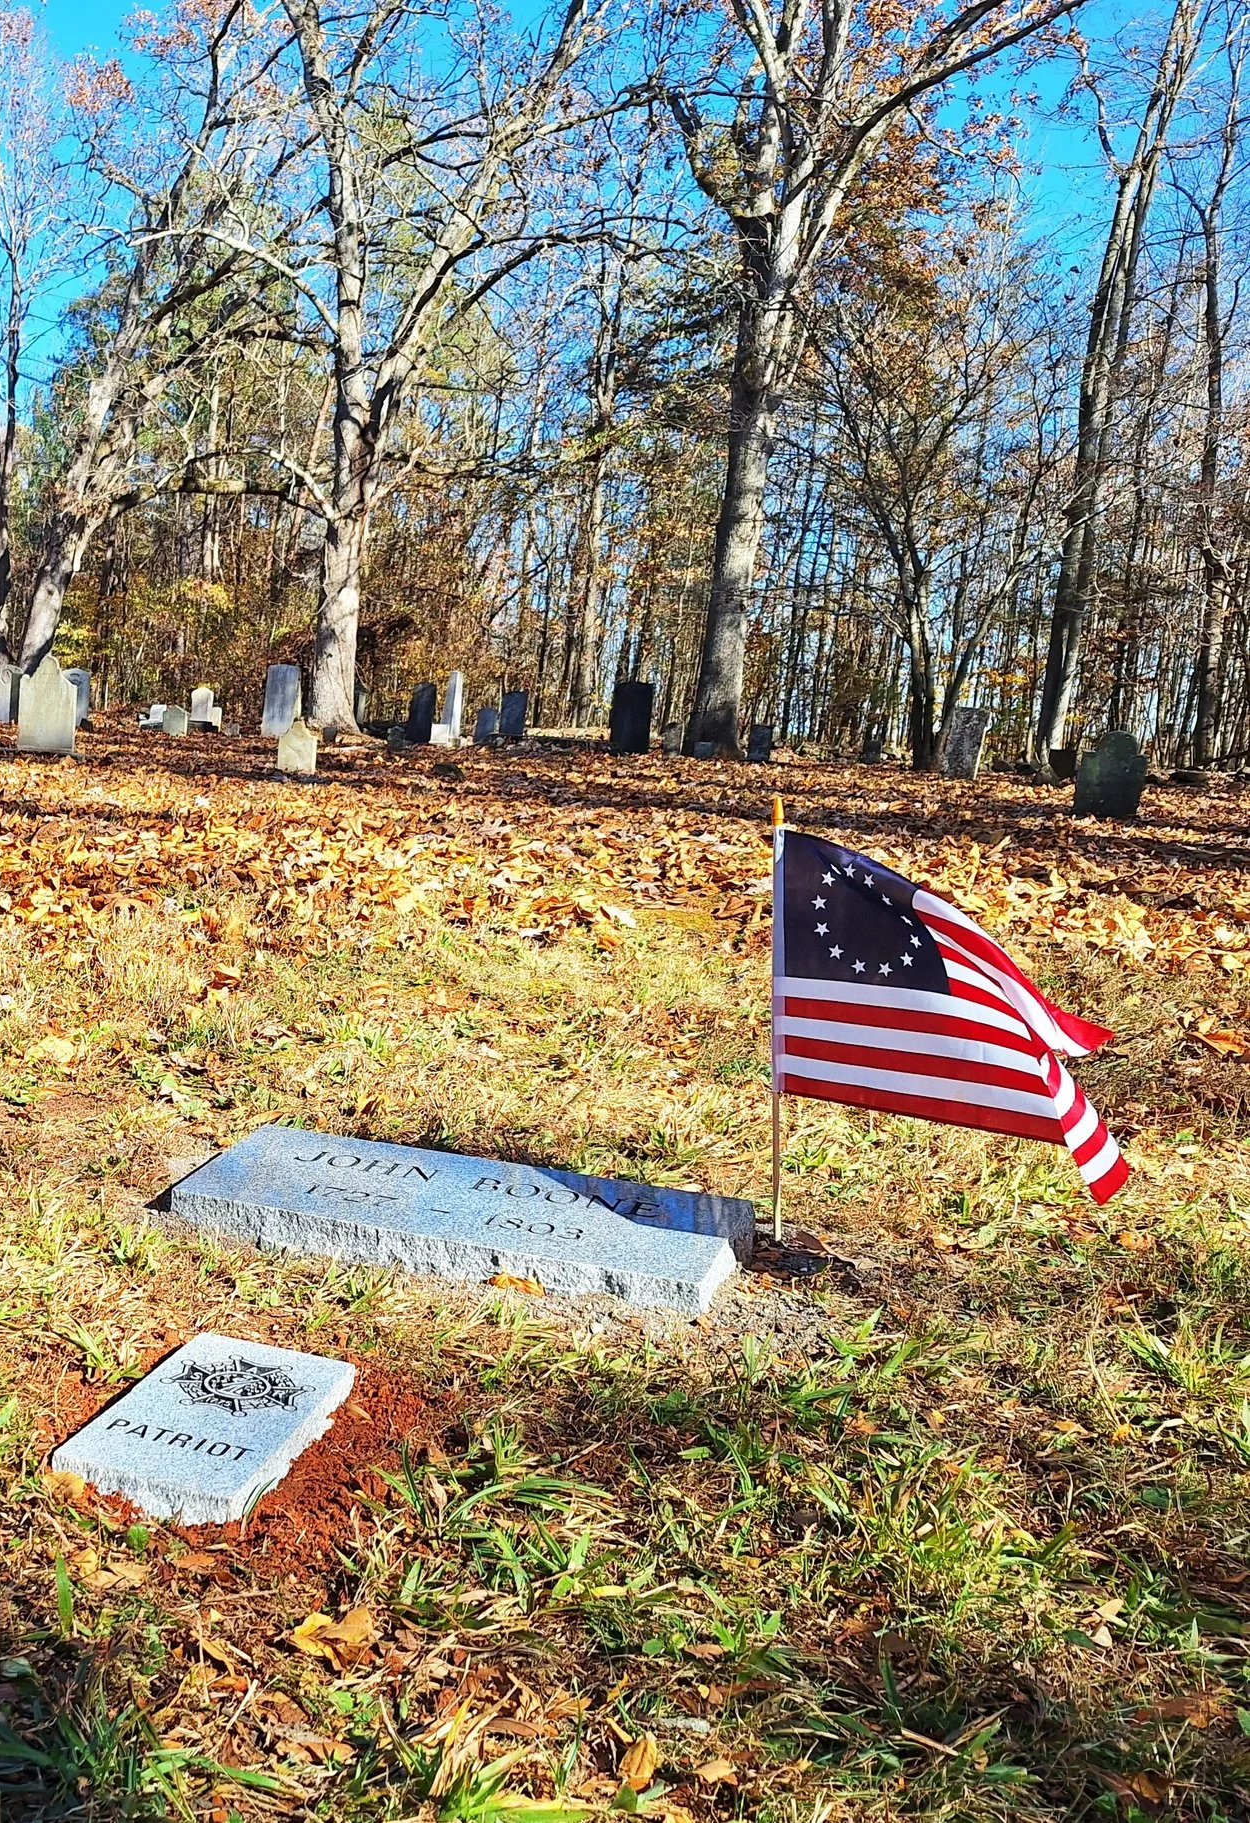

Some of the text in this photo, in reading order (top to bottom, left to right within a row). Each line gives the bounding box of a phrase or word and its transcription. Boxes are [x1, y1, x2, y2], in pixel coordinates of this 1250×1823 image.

[294, 1150, 662, 1219] JOHN BOONE
[303, 1183, 400, 1208] 1727
[484, 1213, 585, 1241] 1803
[106, 1418, 255, 1461] PATRIOT
